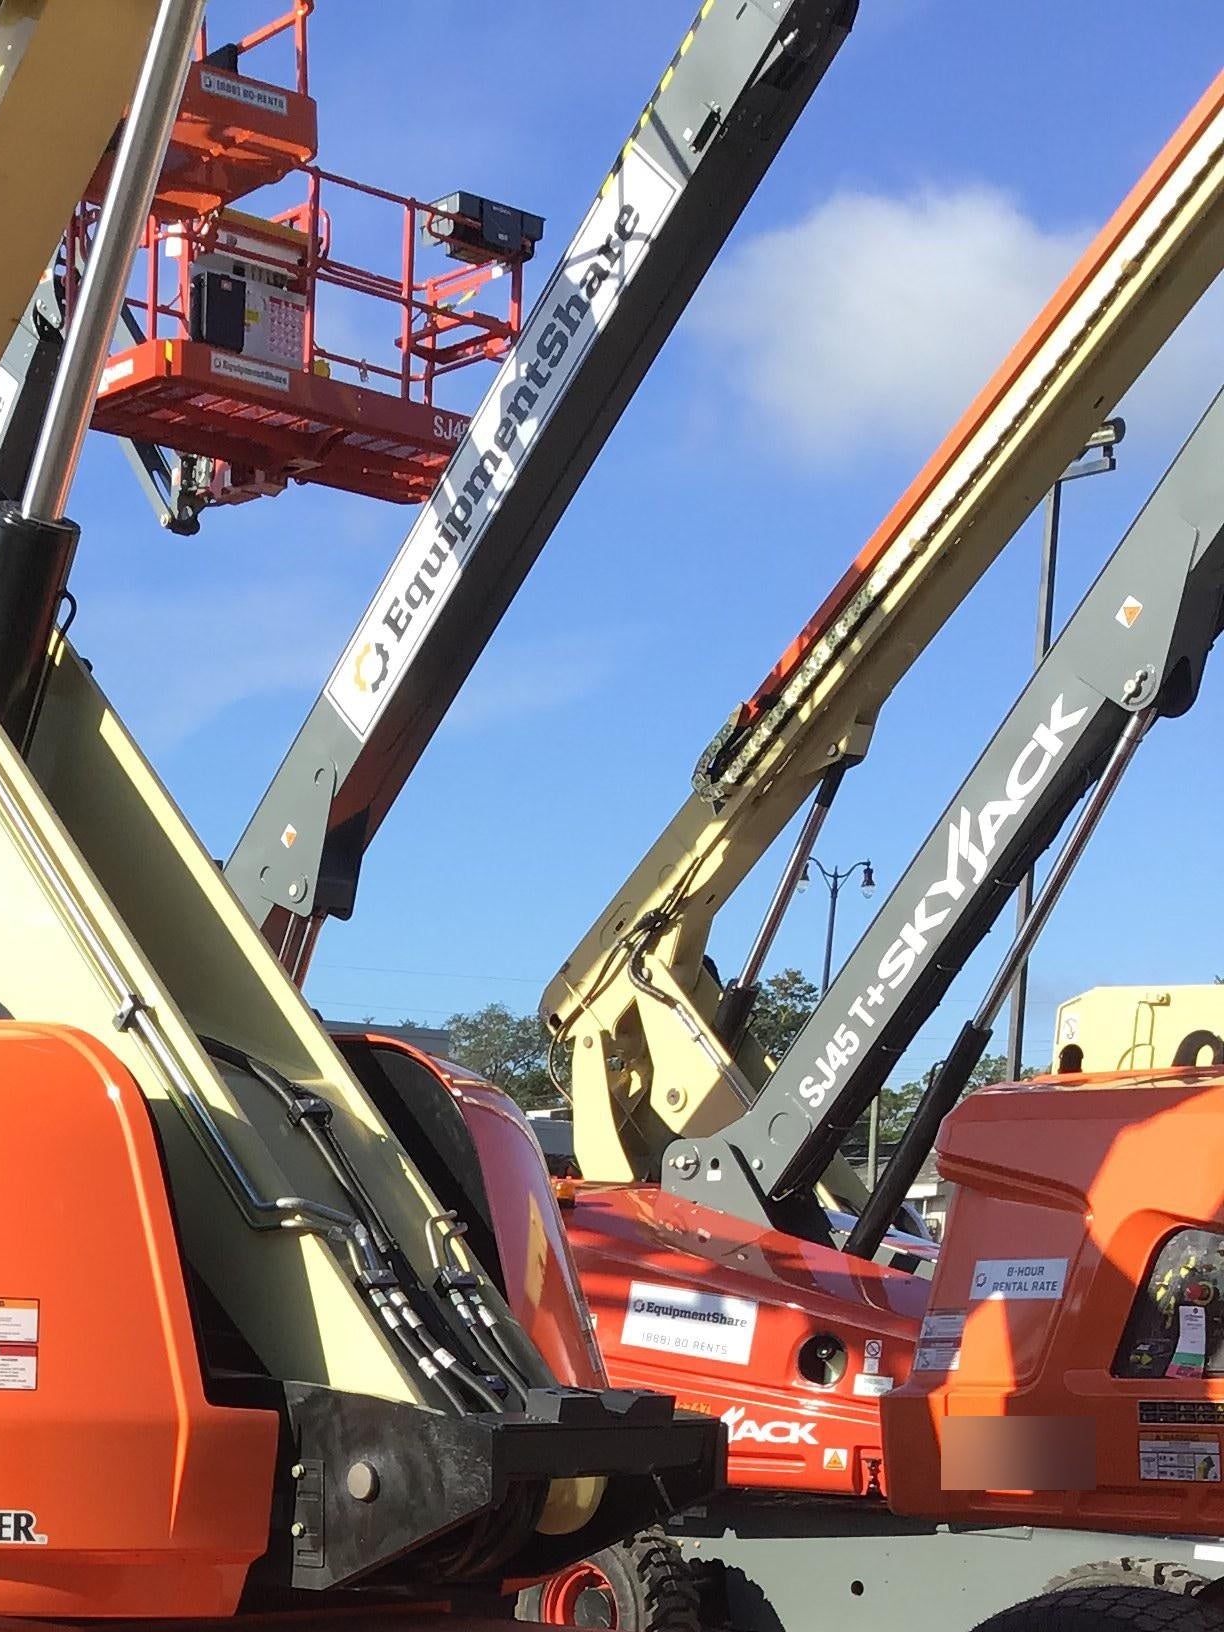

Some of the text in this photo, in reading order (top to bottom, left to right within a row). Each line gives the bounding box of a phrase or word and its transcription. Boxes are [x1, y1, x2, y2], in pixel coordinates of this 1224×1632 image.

[382, 202, 641, 644] EquipmentShare
[798, 1023, 860, 1108] SJ45
[877, 693, 1089, 989] SKYJACK
[1007, 1266, 1044, 1277] 8-HOUR
[992, 1280, 1058, 1292] RENTAL RATE
[646, 1302, 747, 1327] EquipmentShare
